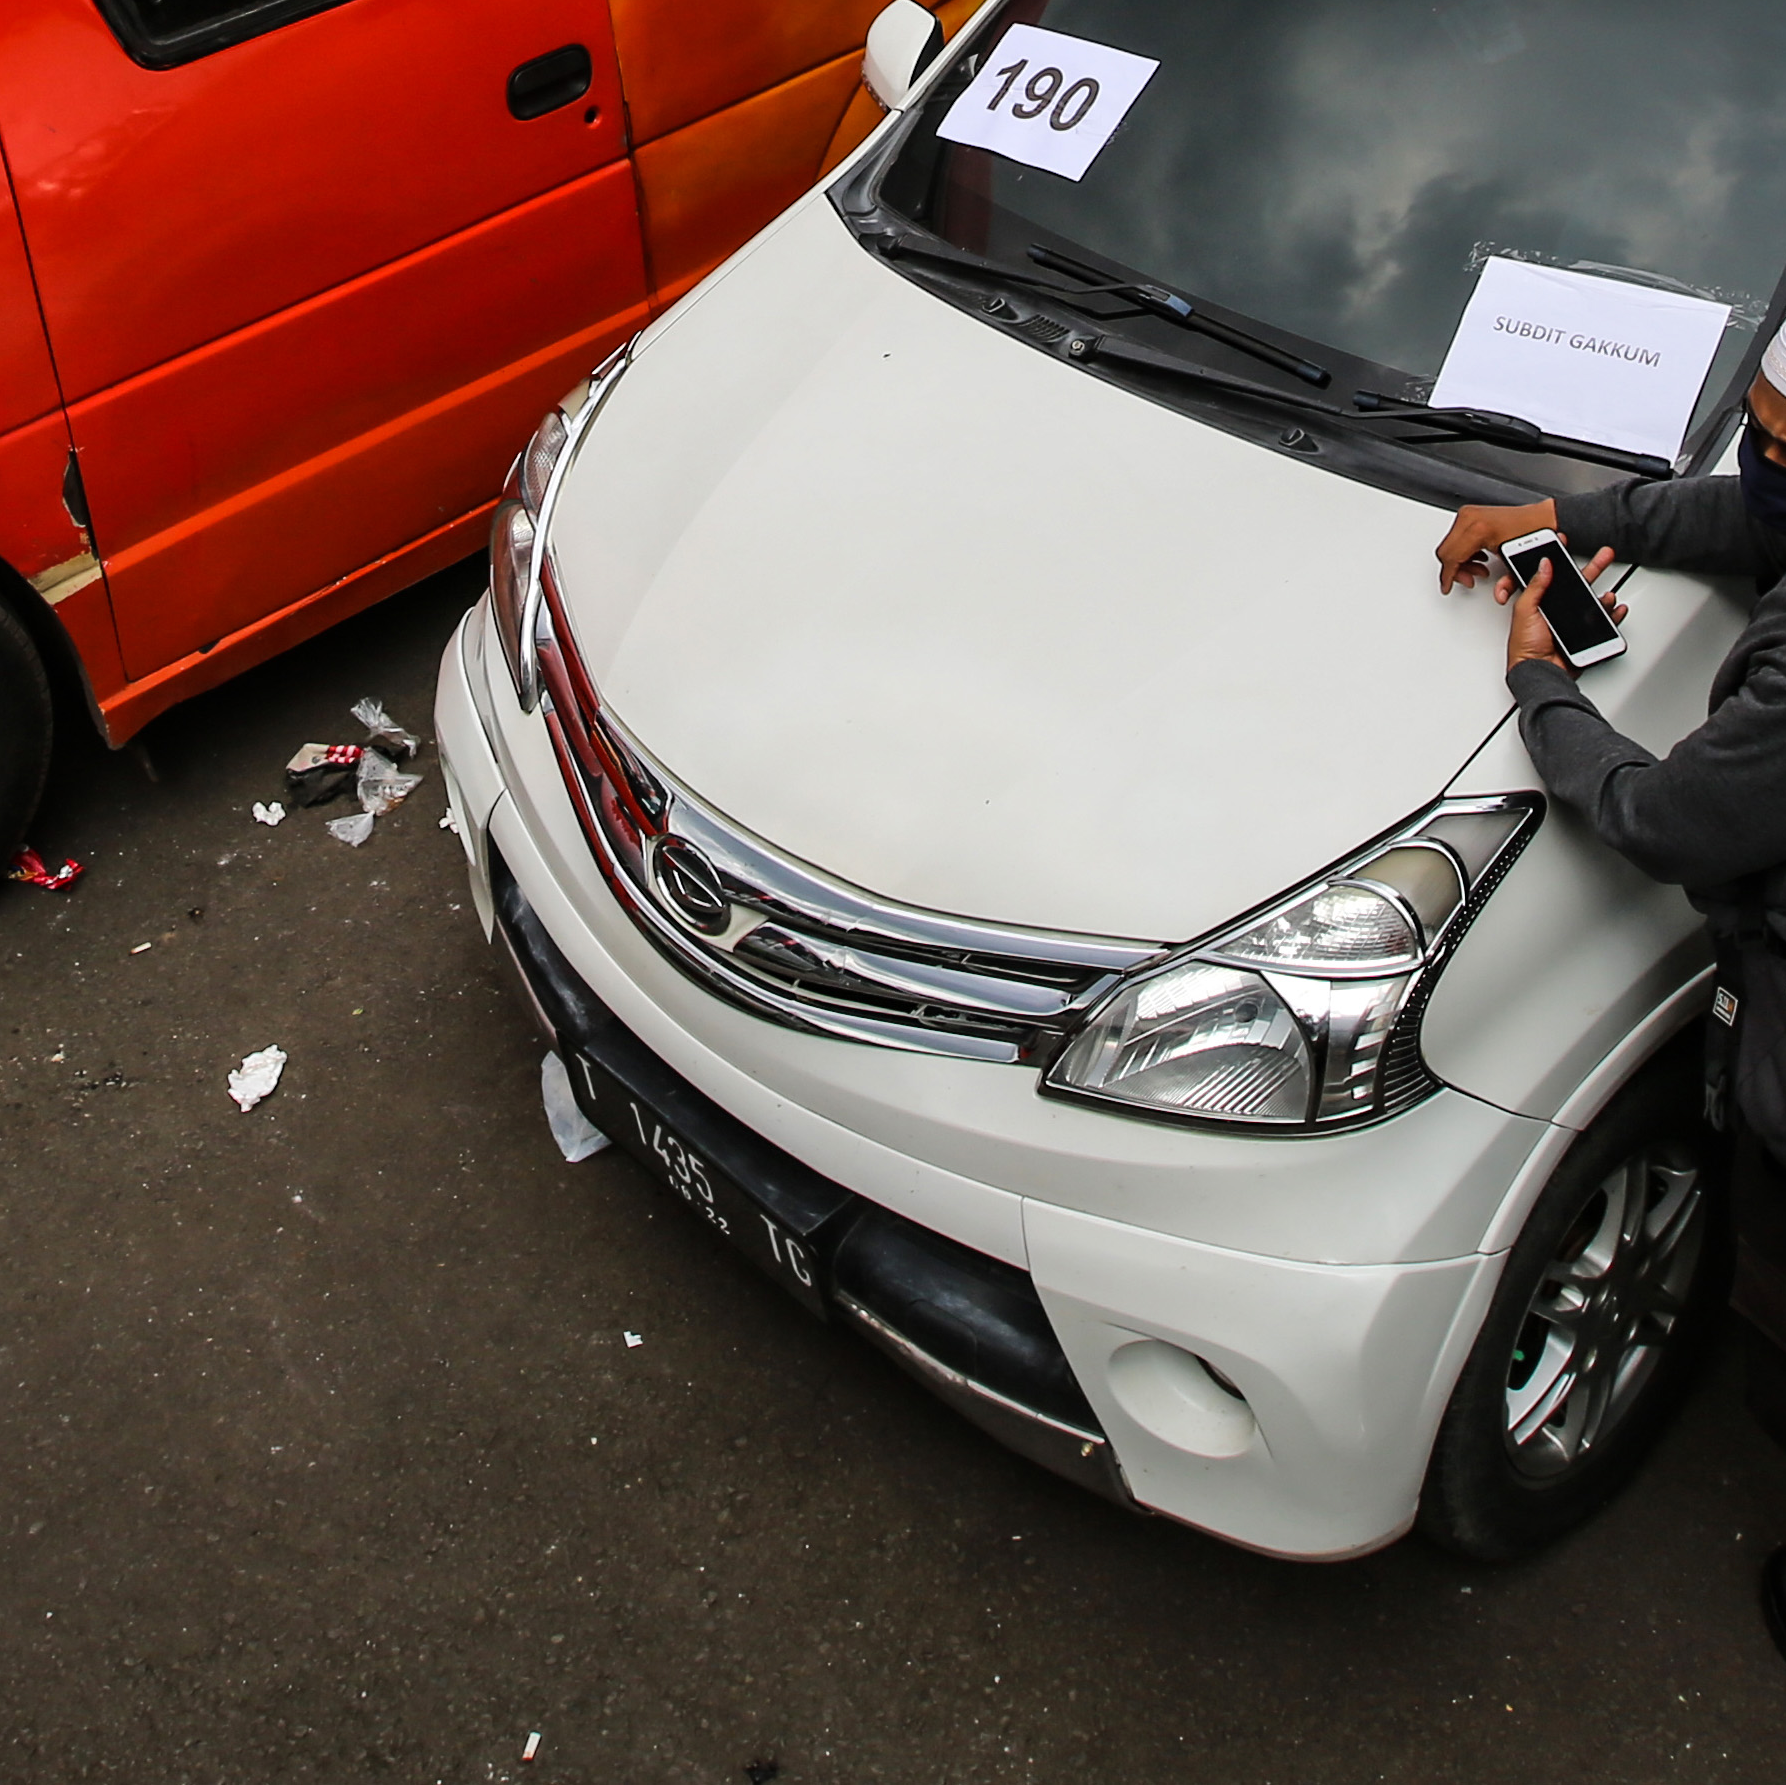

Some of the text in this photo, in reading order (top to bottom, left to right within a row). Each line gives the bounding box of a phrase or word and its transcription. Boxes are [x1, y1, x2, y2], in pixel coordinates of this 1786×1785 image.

[986, 58, 1100, 131] 190
[1493, 315, 1661, 368] SUBDIT GAKKUM
[575, 1052, 596, 1100] T
[629, 1101, 714, 1204] 1435
